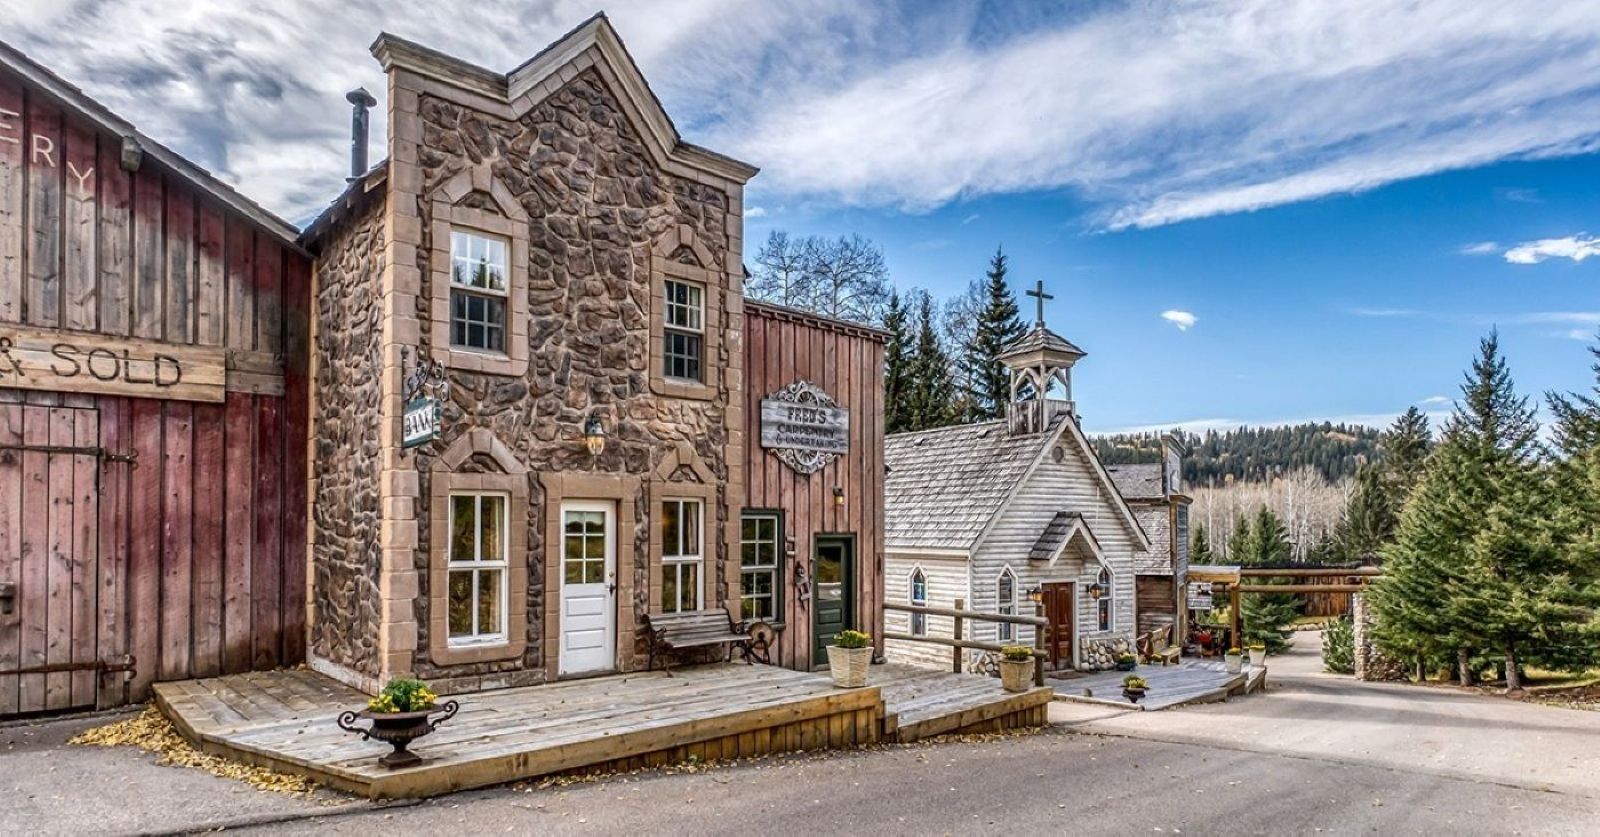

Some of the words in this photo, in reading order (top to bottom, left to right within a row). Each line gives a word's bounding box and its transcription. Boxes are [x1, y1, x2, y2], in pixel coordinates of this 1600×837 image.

[0, 336, 25, 377] &
[51, 343, 182, 387] SOLD
[404, 410, 432, 436] BANK
[787, 406, 826, 424] FRED'S
[777, 423, 835, 438] CARPENTRY
[785, 435, 838, 448] UNDERTAKING
